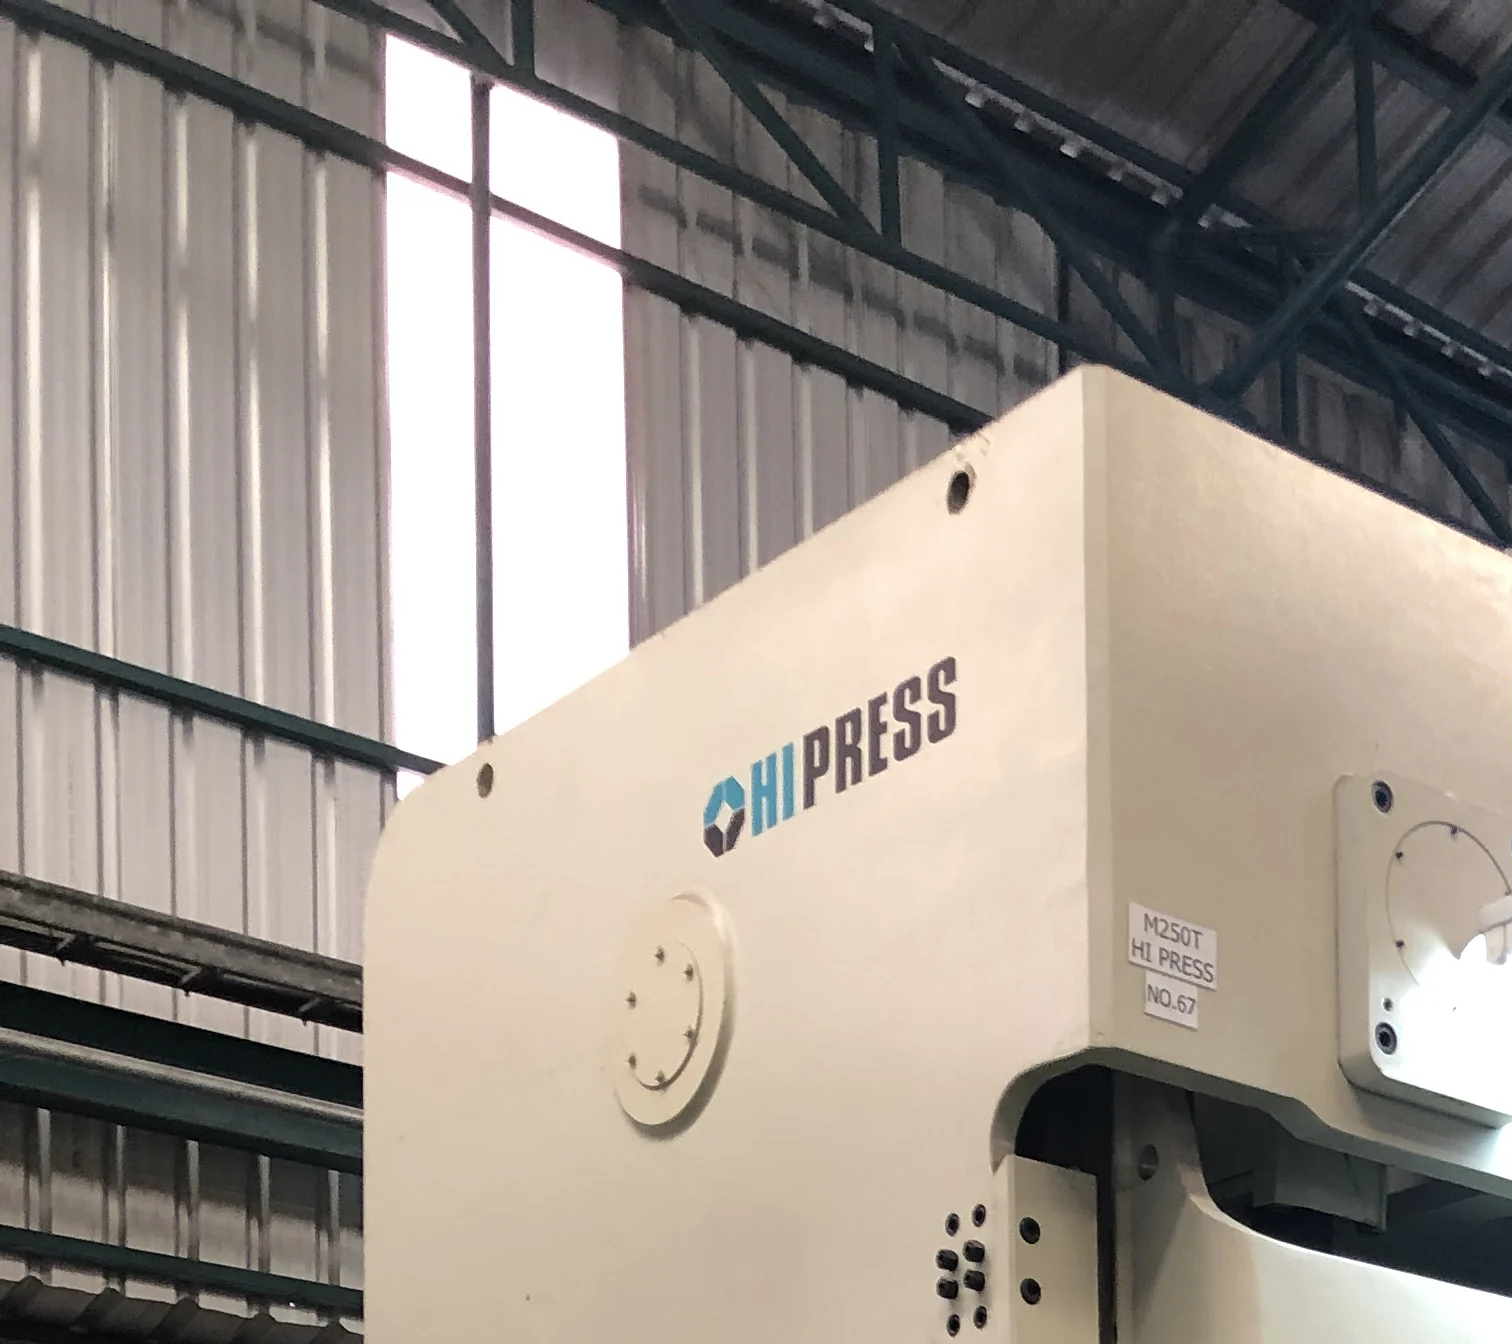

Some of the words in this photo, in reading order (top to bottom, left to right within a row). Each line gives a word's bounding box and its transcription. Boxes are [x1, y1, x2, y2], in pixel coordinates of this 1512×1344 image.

[1143, 911, 1203, 949] M250T
[1131, 937, 1152, 963] HI
[1158, 946, 1214, 983] PRESS
[1147, 983, 1197, 1015] NO.67
